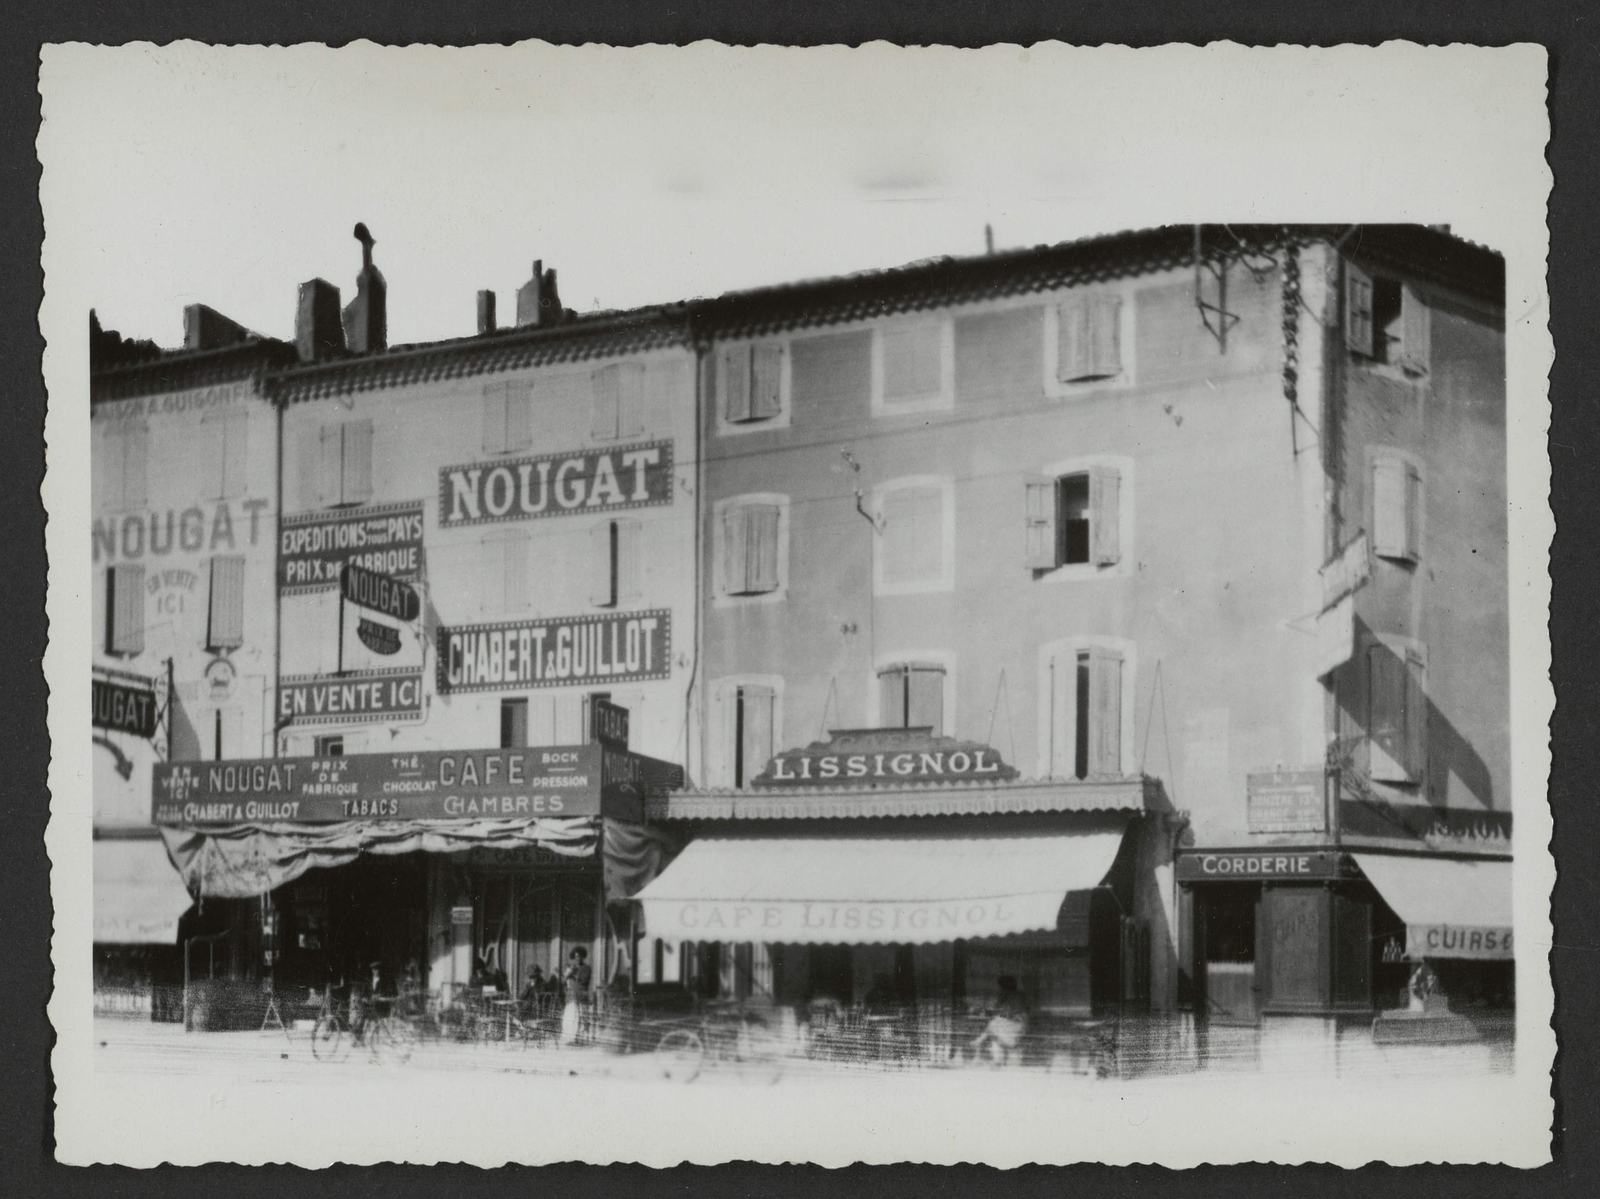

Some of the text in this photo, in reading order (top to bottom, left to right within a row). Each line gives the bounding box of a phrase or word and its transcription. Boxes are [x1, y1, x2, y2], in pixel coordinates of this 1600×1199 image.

[449, 448, 661, 521] NOUGAT
[92, 500, 268, 563] NOUGAT
[282, 522, 367, 555] EXPEDITIONS
[387, 515, 422, 543] PAYS
[287, 559, 325, 583] PRIX
[158, 593, 184, 614] ICI
[347, 567, 411, 617] NOUGAT
[448, 625, 547, 686] CHABERT
[556, 618, 657, 679] GUILLOT
[280, 679, 421, 715] EN VENTE ICI
[311, 760, 349, 772] PRIX
[439, 755, 524, 786] CAFE
[542, 753, 579, 764] BOCK
[773, 751, 998, 780] LISSIGNOL
[209, 764, 297, 793] NOUGAT
[302, 783, 358, 795] FABRIQUE
[319, 772, 339, 783] DE
[383, 780, 438, 793] CHOCOLAT
[533, 776, 588, 788] PRESSION
[184, 801, 234, 822] CHABERT
[245, 800, 300, 819] GUILLOT
[342, 799, 399, 818] TABACS
[443, 795, 564, 815] CHAMBRES
[1203, 855, 1311, 874] CORDERIE
[678, 901, 1015, 931] CAFE LISSIGNOL
[1427, 926, 1497, 951] CUIRS
